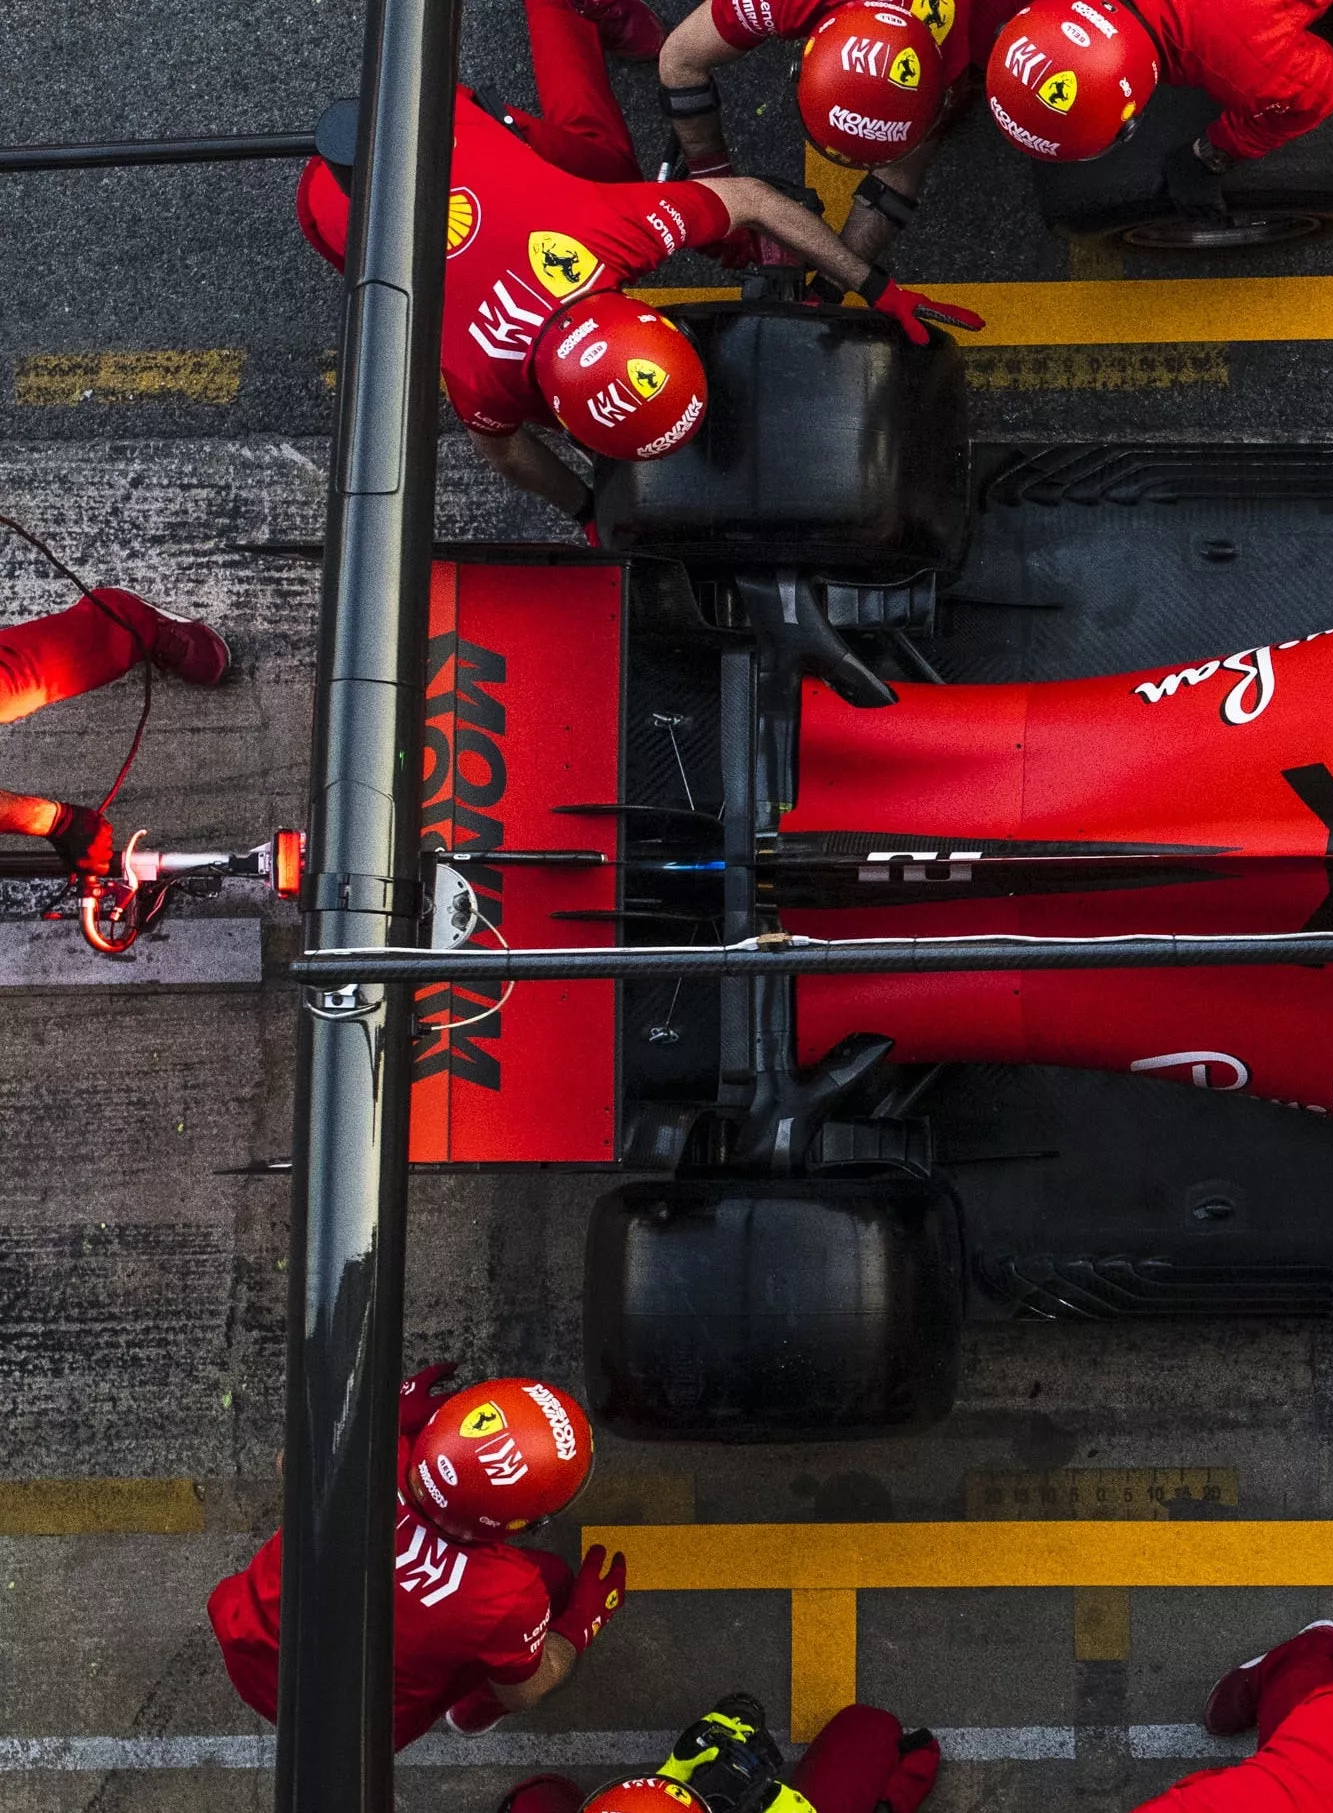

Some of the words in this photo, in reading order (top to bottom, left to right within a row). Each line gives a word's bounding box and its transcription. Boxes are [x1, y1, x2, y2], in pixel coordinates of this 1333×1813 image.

[1066, 24, 1087, 44] BELL
[829, 105, 911, 134] WINNOW
[829, 114, 906, 141] MISSION
[646, 213, 675, 255] UBLOT
[583, 344, 604, 363] BELL
[522, 1386, 571, 1460] WINNOW
[534, 1384, 576, 1460] MISSION
[439, 1458, 455, 1483] BELL
